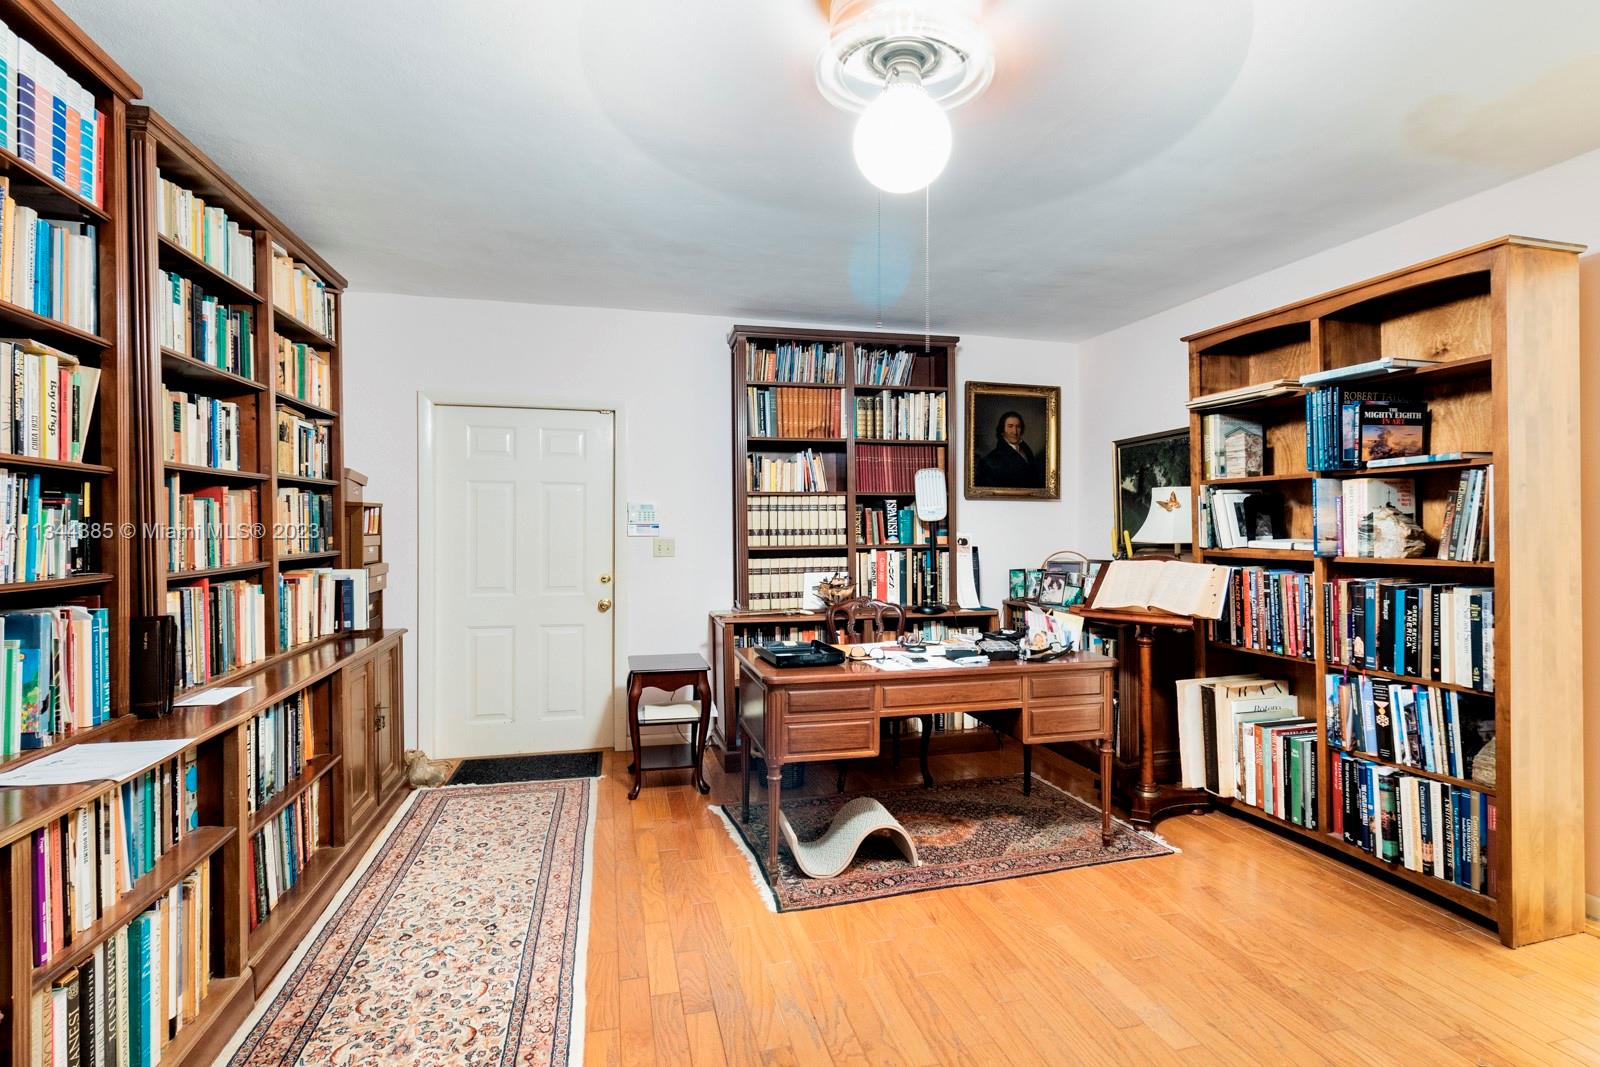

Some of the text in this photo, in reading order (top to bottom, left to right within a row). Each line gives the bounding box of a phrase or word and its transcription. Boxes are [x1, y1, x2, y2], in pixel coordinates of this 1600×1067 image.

[1344, 391, 1377, 401] ROBERT
[48, 380, 57, 436] Bay of Pigs
[1364, 411, 1394, 419] MIGHTY
[886, 503, 898, 536] SPANISH
[107, 935, 116, 1041] REMBRANDT
[89, 1023, 95, 1035] OF
